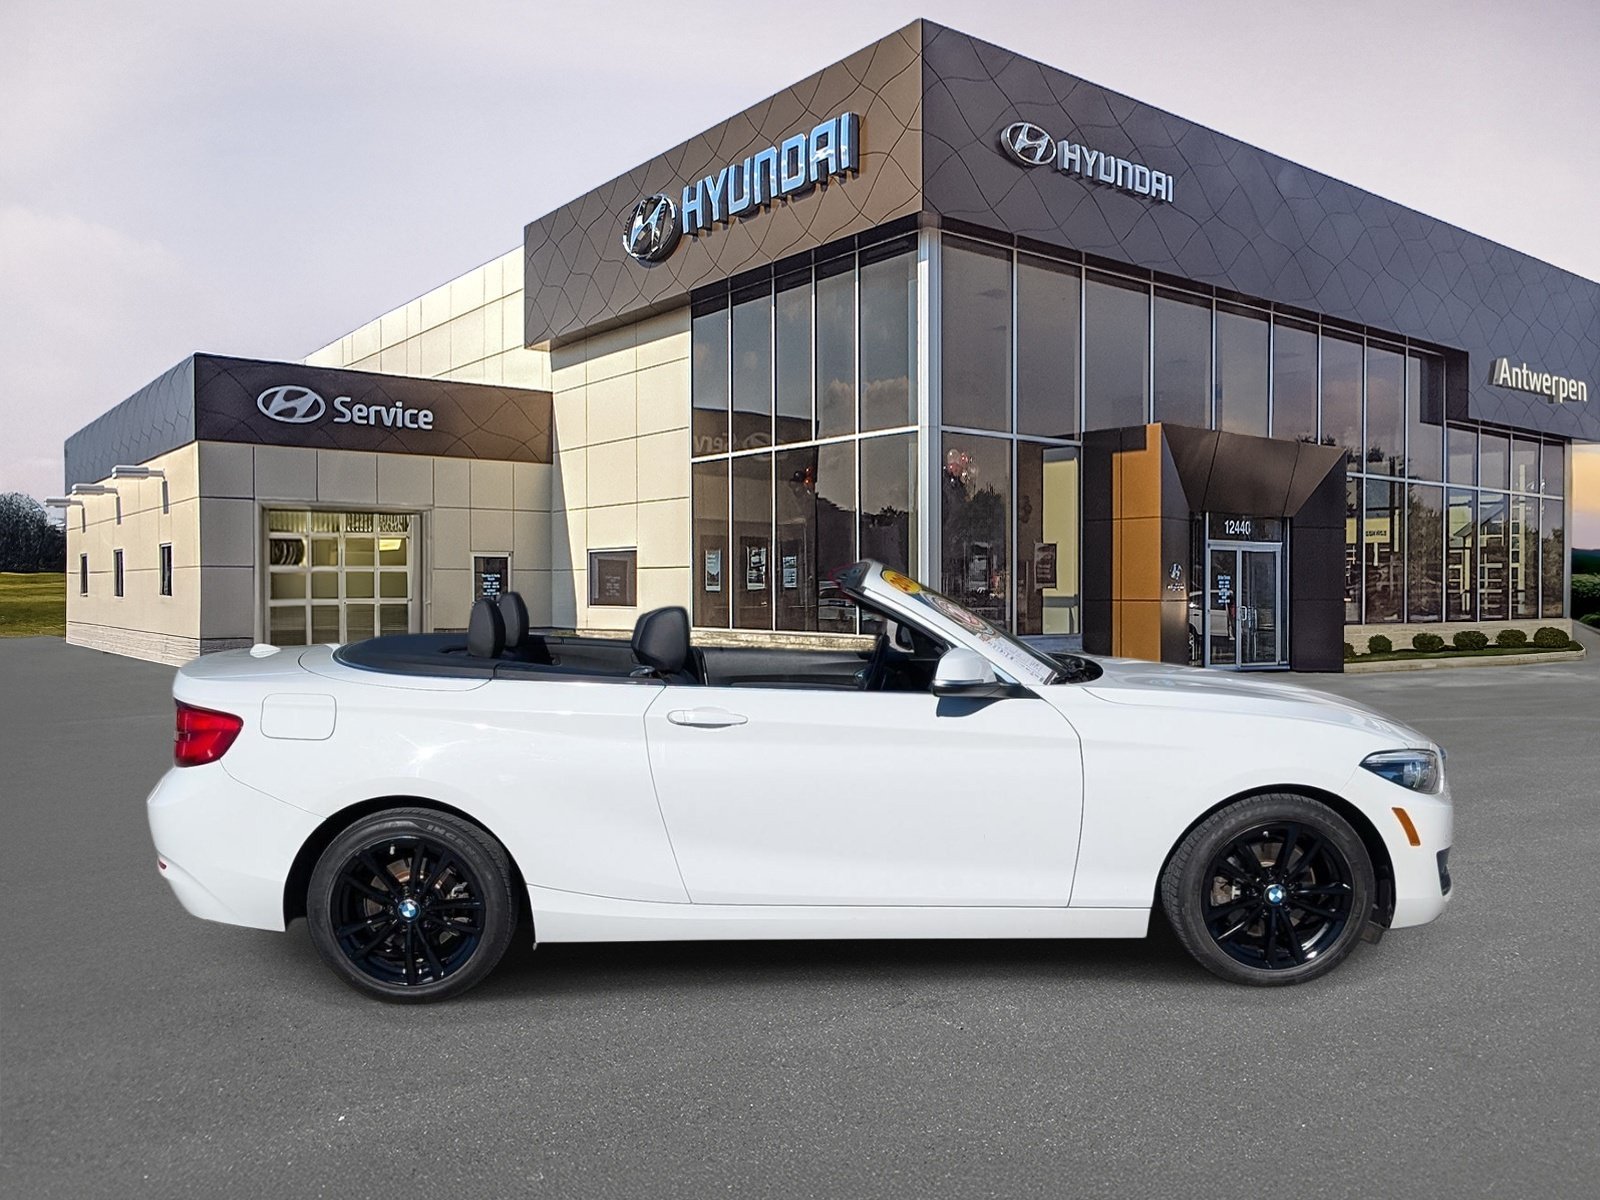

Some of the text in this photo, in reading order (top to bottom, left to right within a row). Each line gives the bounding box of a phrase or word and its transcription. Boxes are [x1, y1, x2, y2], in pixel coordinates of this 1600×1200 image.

[682, 112, 859, 235] HYUNDAI
[1057, 140, 1174, 203] HYUNDAI
[1494, 357, 1587, 403] Antwerpen
[333, 396, 434, 430] Service
[1224, 519, 1251, 535] 12440
